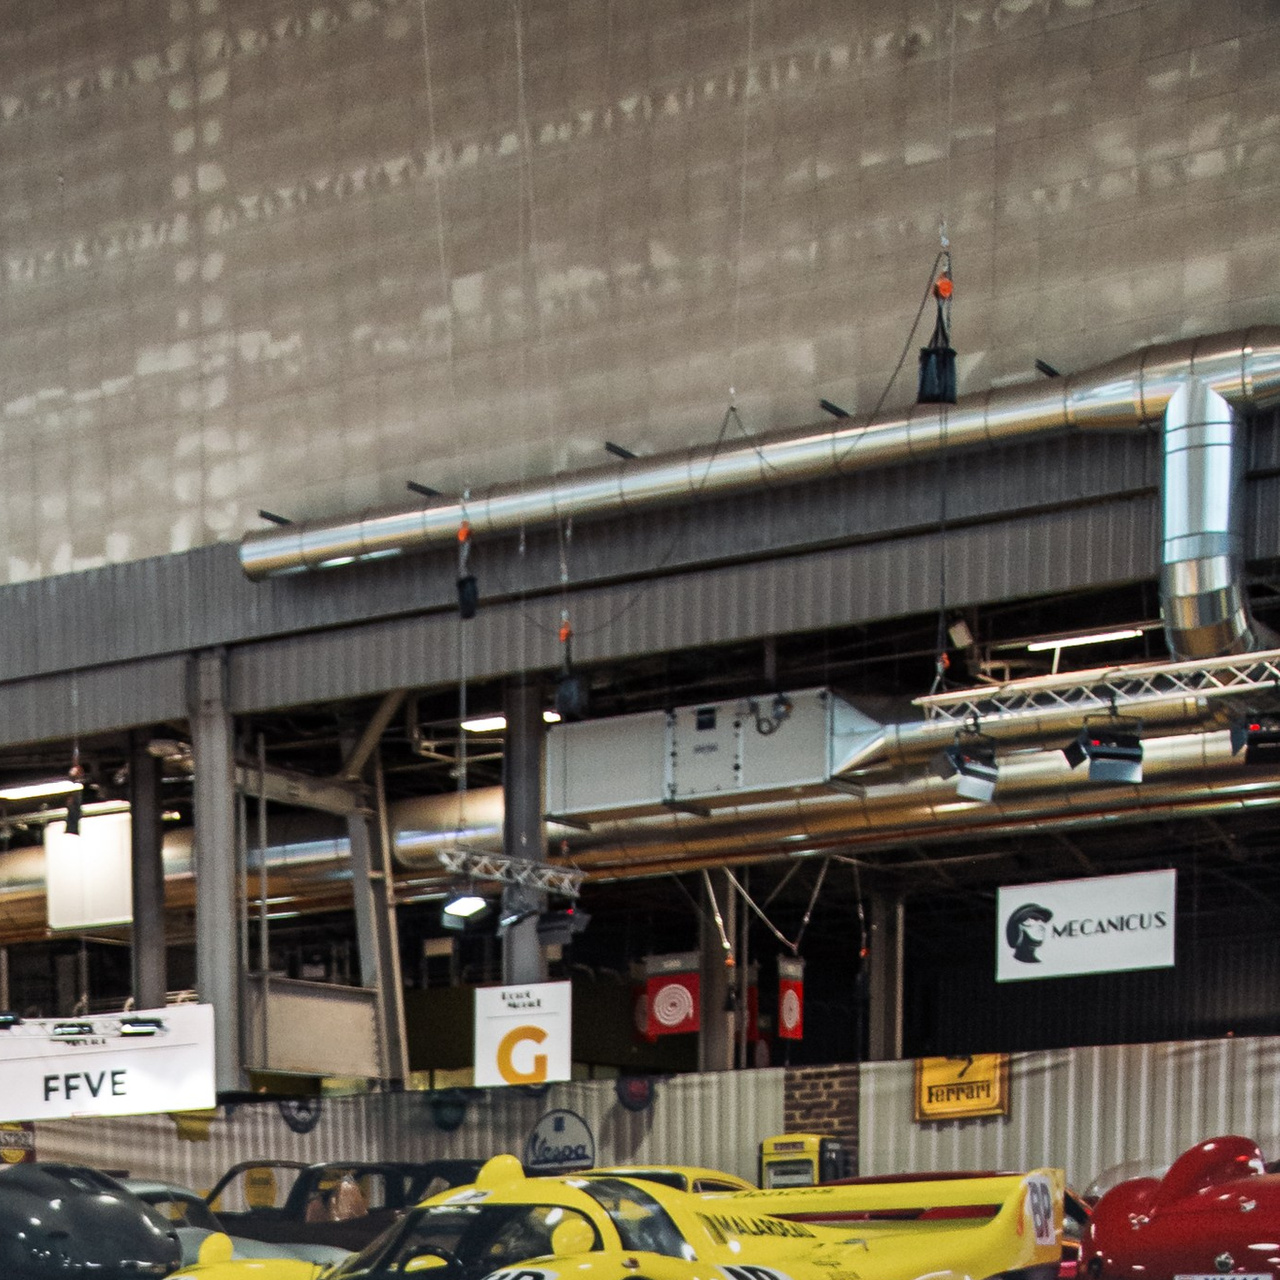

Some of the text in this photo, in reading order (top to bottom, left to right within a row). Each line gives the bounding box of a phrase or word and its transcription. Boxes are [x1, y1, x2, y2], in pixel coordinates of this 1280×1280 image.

[1052, 911, 1167, 939] MECANICUS
[496, 1025, 549, 1086] G
[43, 1069, 127, 1102] FFVE
[926, 1080, 991, 1103] Ferrari
